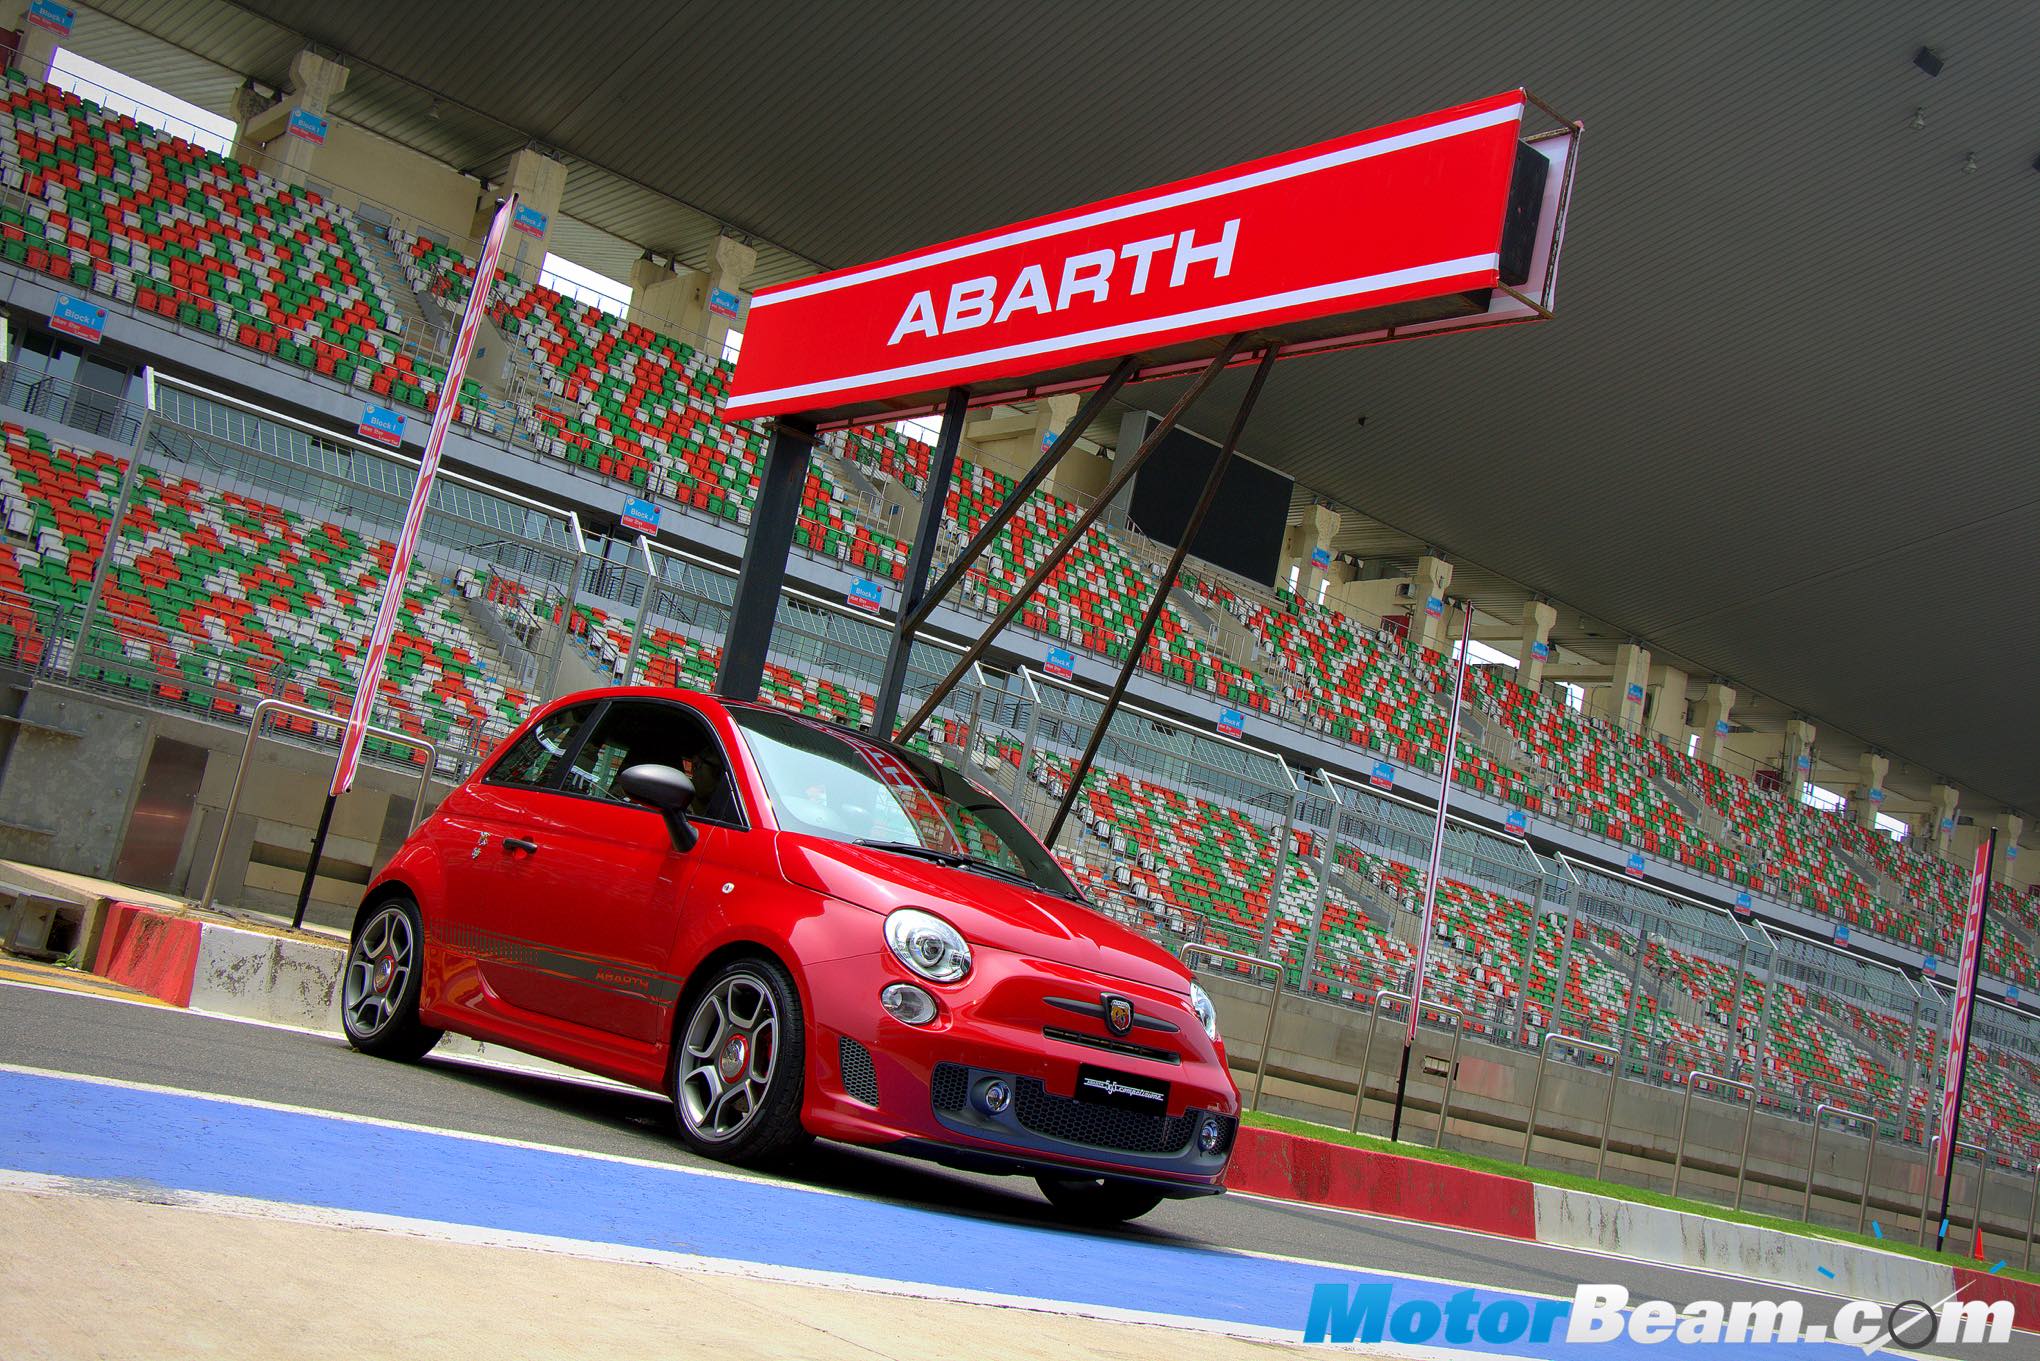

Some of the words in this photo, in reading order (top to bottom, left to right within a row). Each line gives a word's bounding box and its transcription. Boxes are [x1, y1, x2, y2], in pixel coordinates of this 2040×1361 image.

[887, 218, 1241, 346] ABARTH
[64, 308, 90, 325] Block
[370, 416, 392, 430] Block
[630, 507, 649, 520] Block
[595, 967, 650, 993] ABARTH
